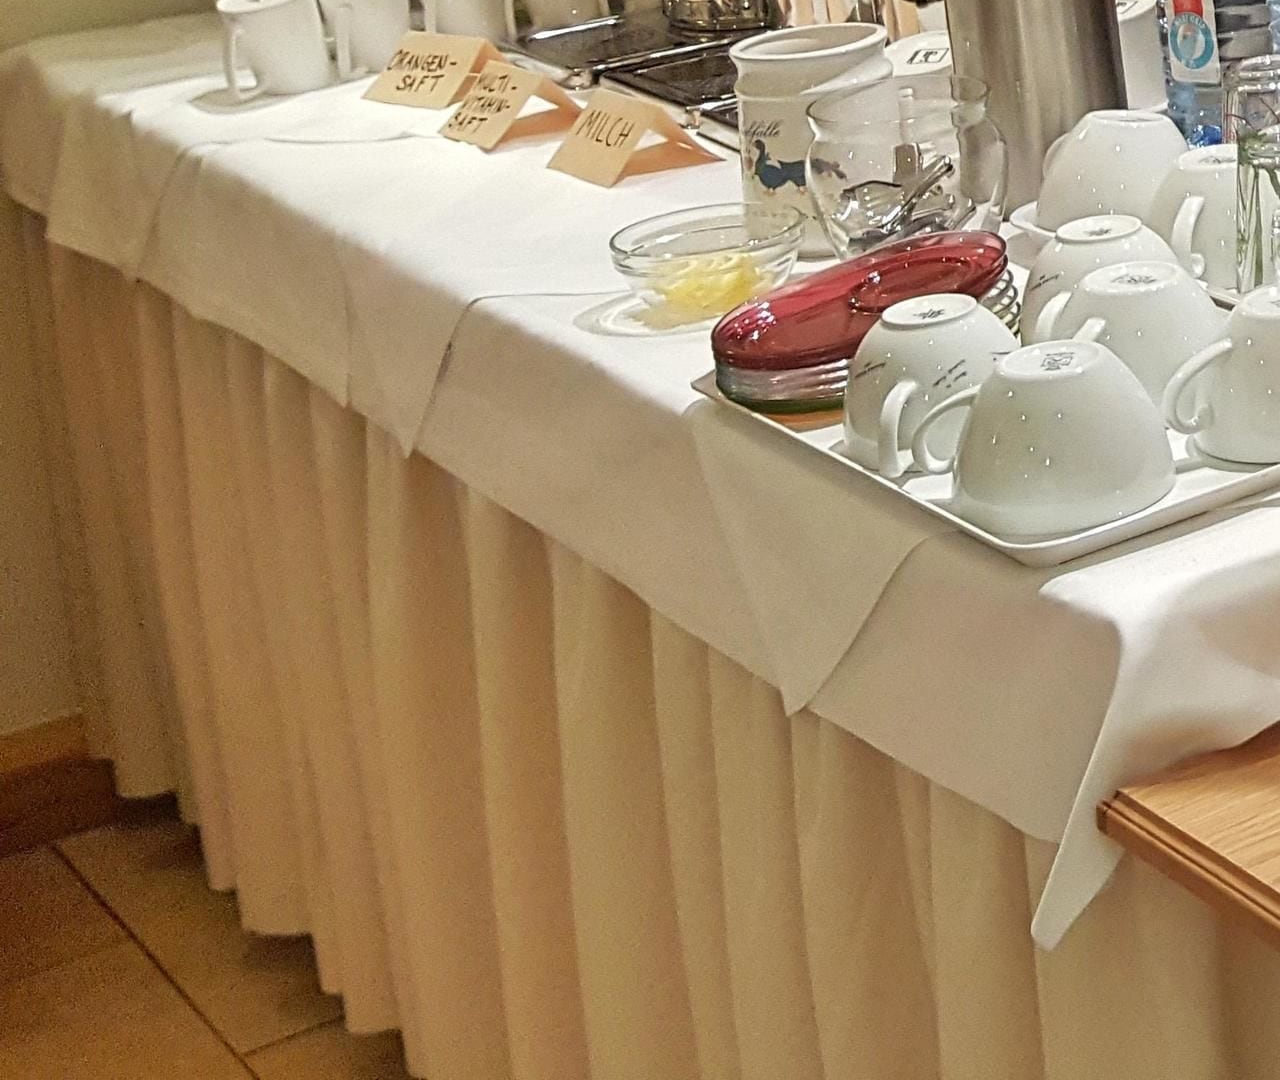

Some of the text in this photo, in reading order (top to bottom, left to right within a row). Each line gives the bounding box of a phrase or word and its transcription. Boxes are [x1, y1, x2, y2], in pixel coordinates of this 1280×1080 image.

[388, 49, 458, 71] ORANGEN-
[396, 74, 446, 92] SAFT
[448, 114, 489, 135] SAFT
[576, 109, 636, 148] MILCH
